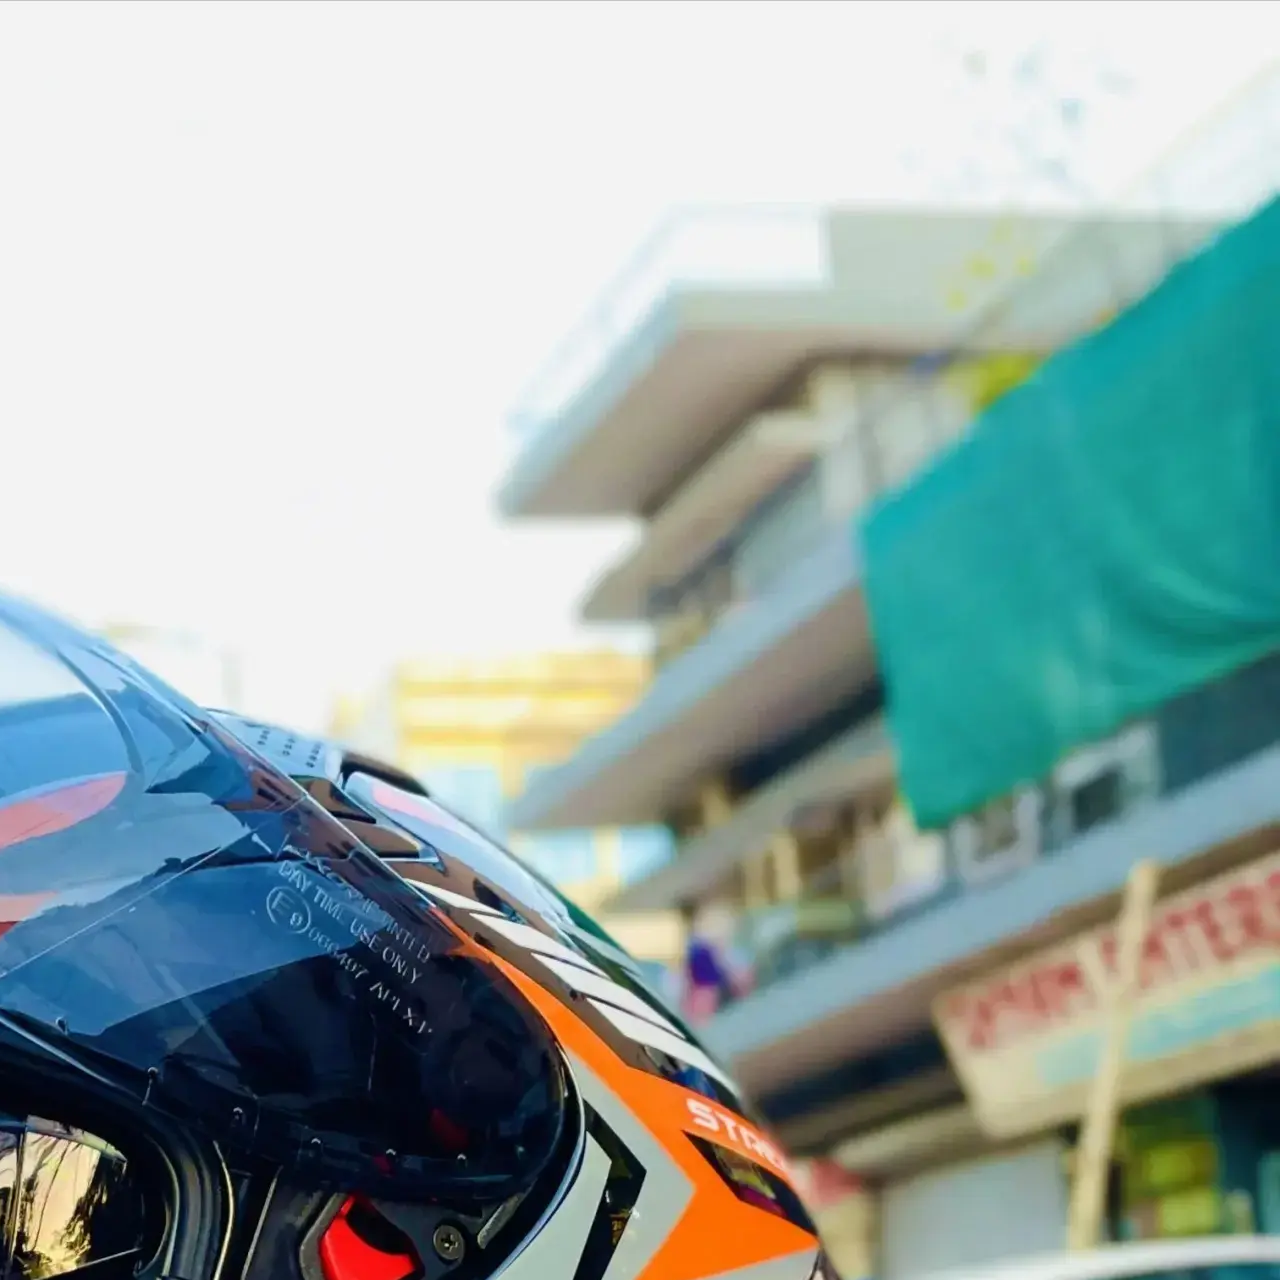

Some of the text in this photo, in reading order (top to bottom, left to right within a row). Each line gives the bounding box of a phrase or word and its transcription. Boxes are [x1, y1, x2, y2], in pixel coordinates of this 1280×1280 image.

[279, 860, 423, 984] DAY TIME USE ONLY
